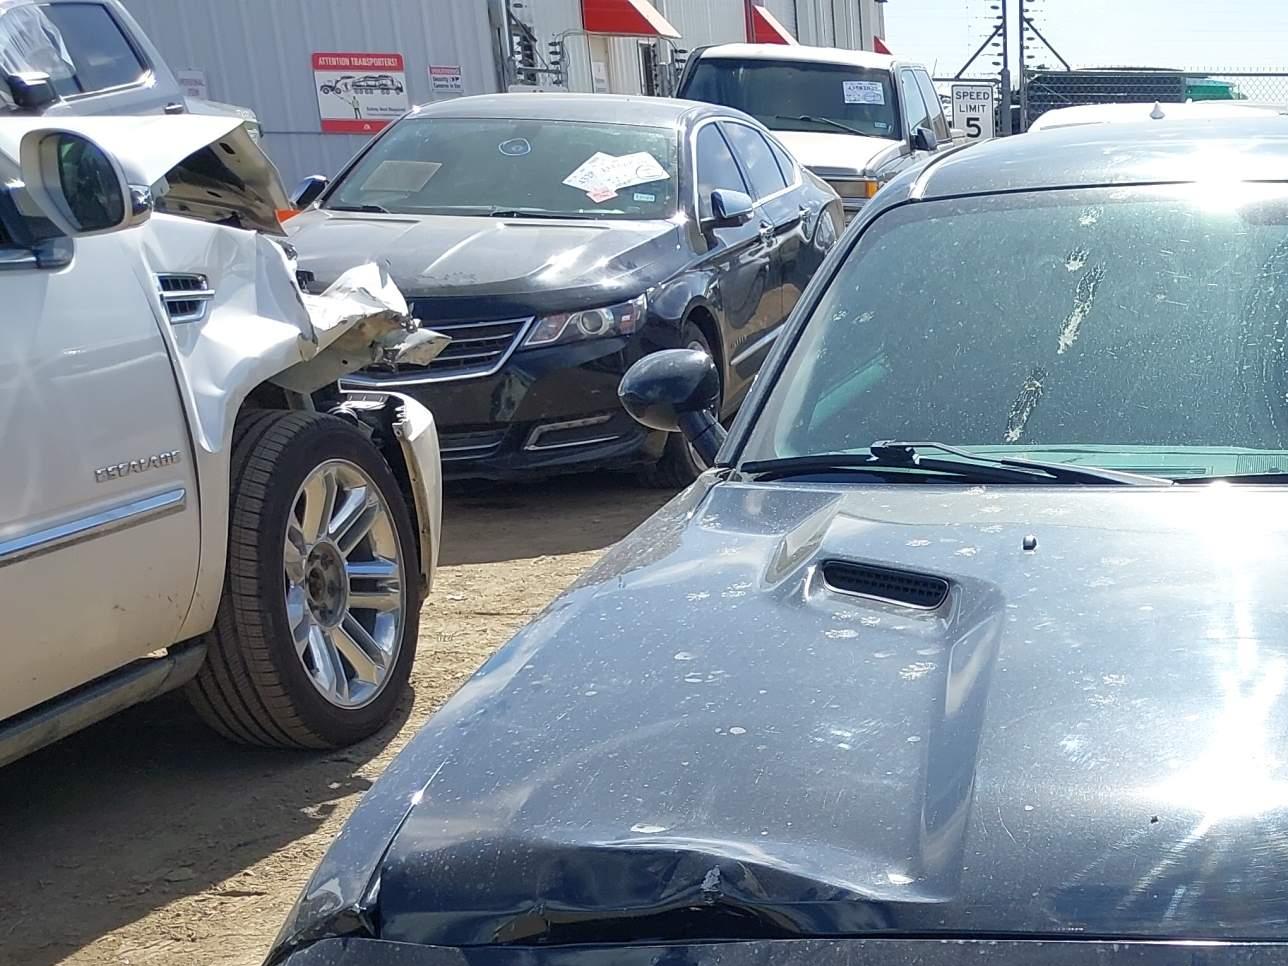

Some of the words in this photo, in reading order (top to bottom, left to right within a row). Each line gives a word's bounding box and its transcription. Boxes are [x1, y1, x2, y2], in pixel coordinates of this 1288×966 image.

[319, 57, 349, 65] ATTENTION
[955, 91, 990, 100] SPEED
[959, 104, 986, 113] LIMIT
[966, 117, 981, 138] 5
